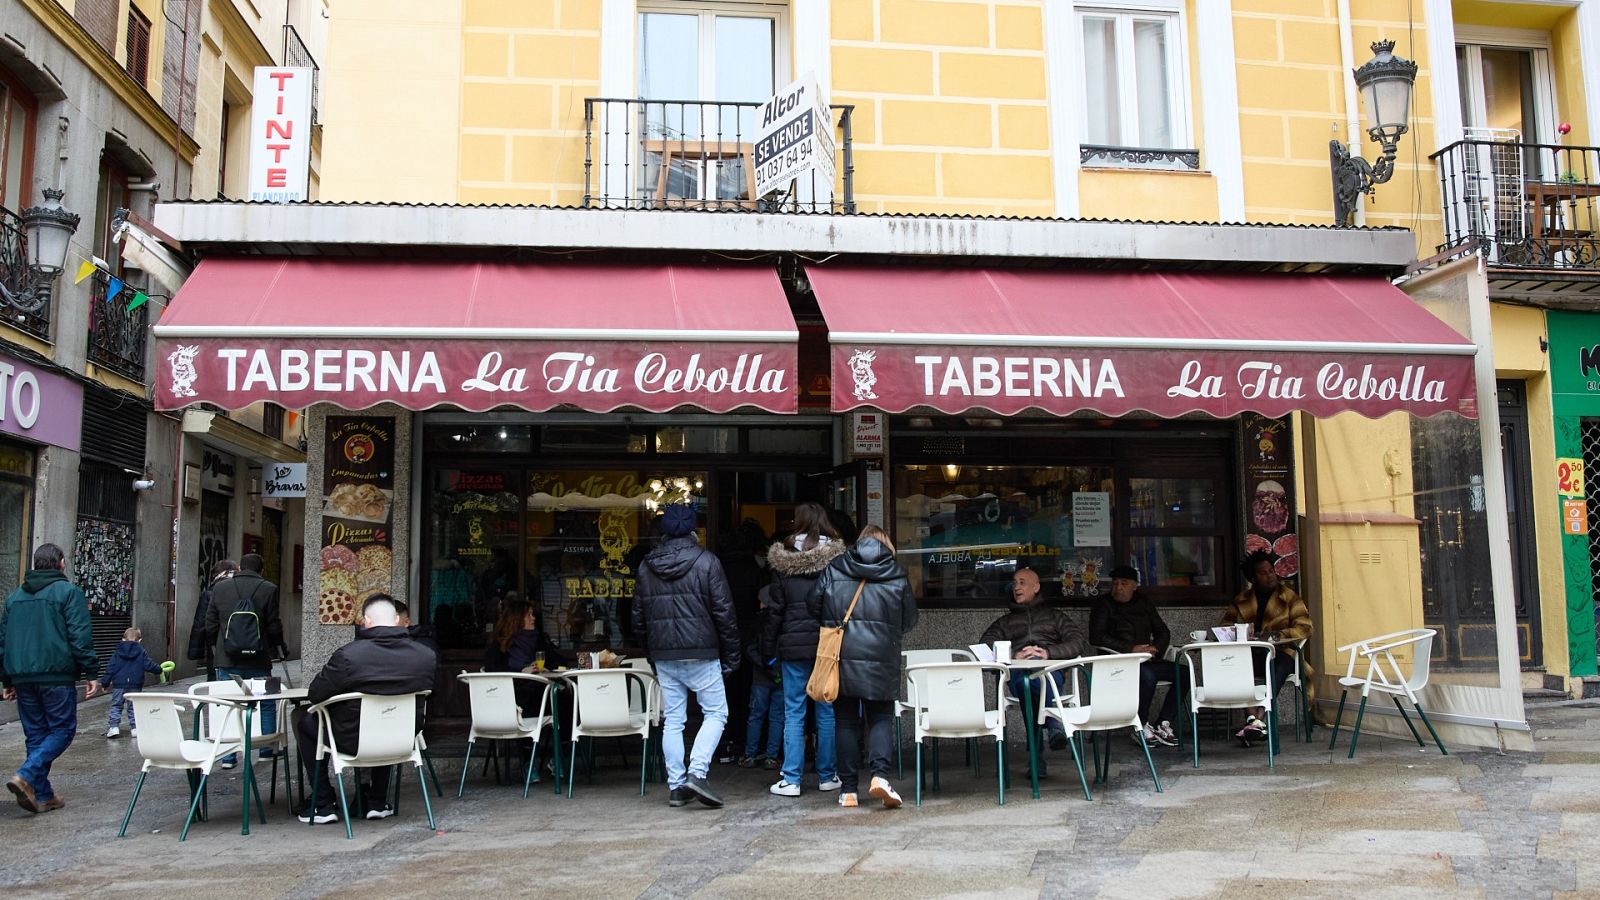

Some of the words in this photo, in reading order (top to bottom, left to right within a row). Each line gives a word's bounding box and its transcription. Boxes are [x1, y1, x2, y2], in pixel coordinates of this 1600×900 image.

[762, 85, 805, 129] Altor
[266, 73, 294, 188] TINTE
[758, 138, 770, 163] SE
[771, 113, 809, 154] VENDE
[756, 169, 766, 188] 91
[767, 154, 784, 179] 037
[786, 146, 798, 169] 64
[800, 138, 813, 161] 94
[217, 349, 447, 393] TABERNA
[461, 351, 529, 393] La
[542, 351, 622, 393] Tia
[634, 352, 789, 394] Cebolla
[914, 356, 1126, 398] TABERNA
[1166, 360, 1227, 398] La
[1237, 361, 1306, 399] Tia
[1316, 362, 1449, 402] Cebolla
[274, 466, 292, 480] Las
[1558, 463, 1572, 492] 2
[1571, 463, 1582, 472] 50
[1573, 479, 1580, 492] €
[265, 480, 306, 495] Bravas
[327, 521, 373, 547] Pizzas
